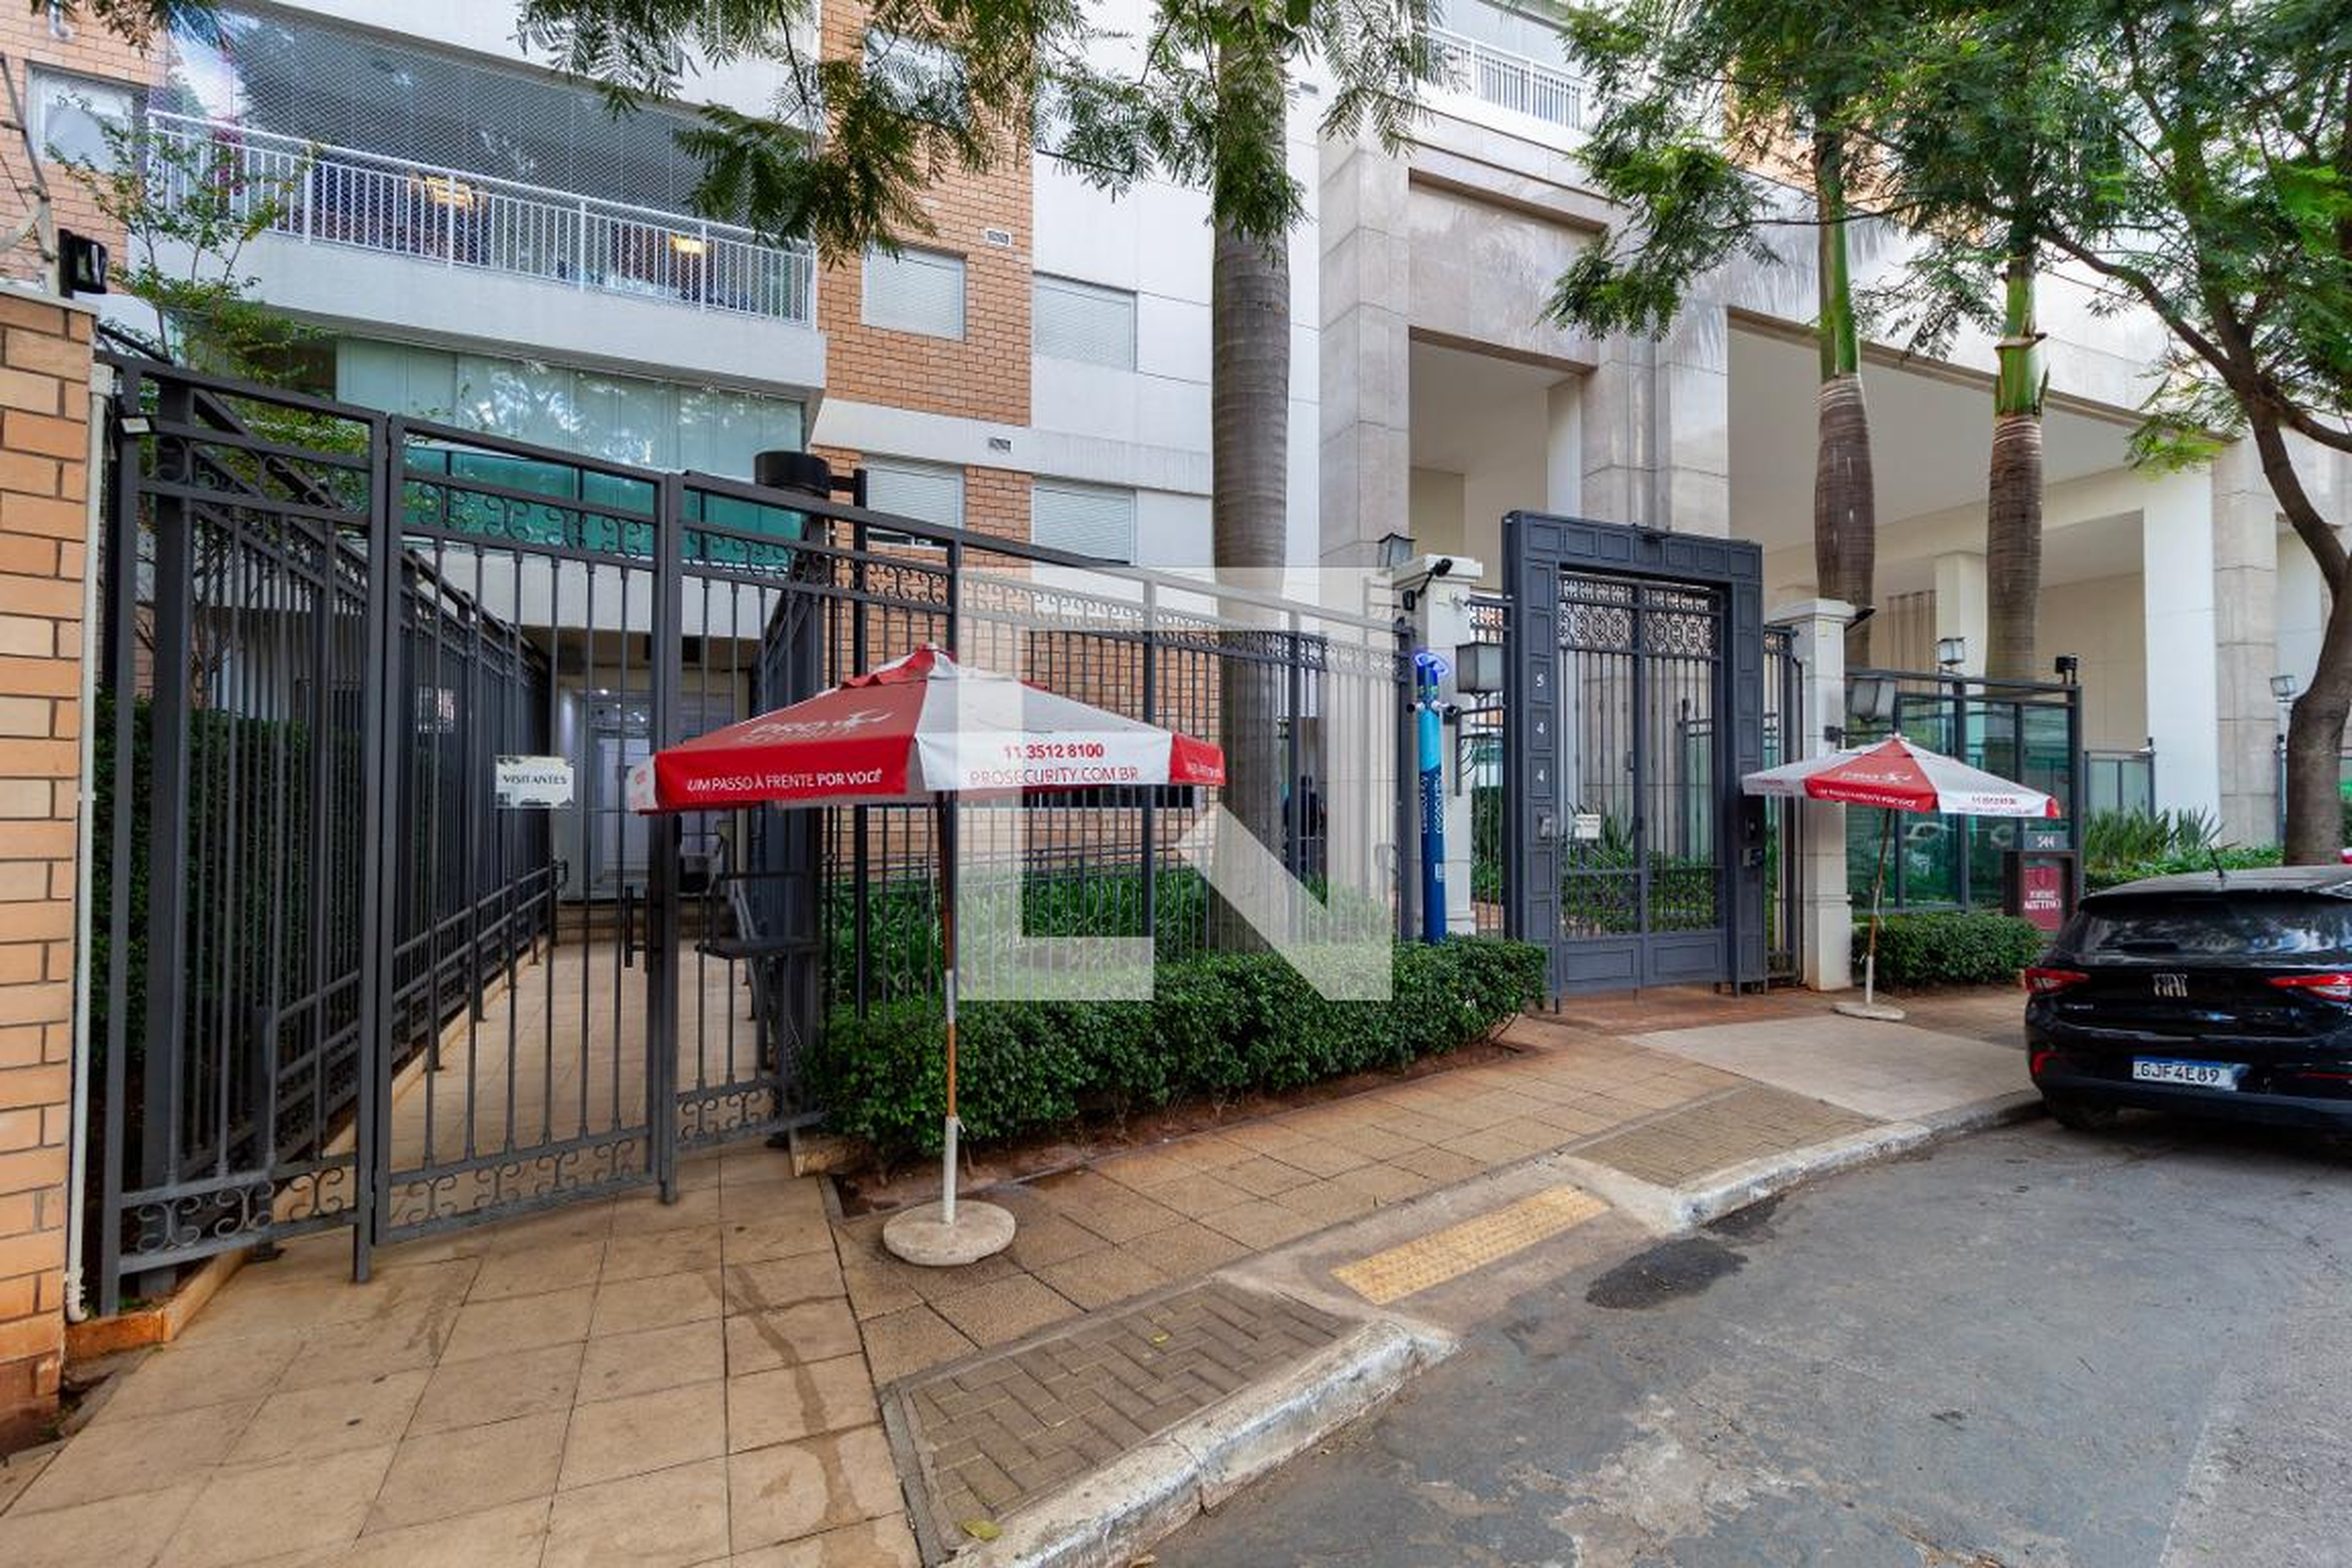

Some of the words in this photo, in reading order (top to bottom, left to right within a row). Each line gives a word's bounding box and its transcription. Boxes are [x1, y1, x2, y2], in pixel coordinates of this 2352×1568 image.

[1005, 745, 1022, 760] 11
[1026, 744, 1064, 760] 3512
[1067, 743, 1104, 758] 8100
[503, 774, 567, 785] VISITANTES
[687, 778, 710, 791] UM
[712, 775, 753, 791] PASSO
[766, 772, 815, 788] FRENTE
[816, 770, 845, 786] POR
[846, 767, 883, 785] VOCÊ
[2152, 973, 2188, 998] FIAT
